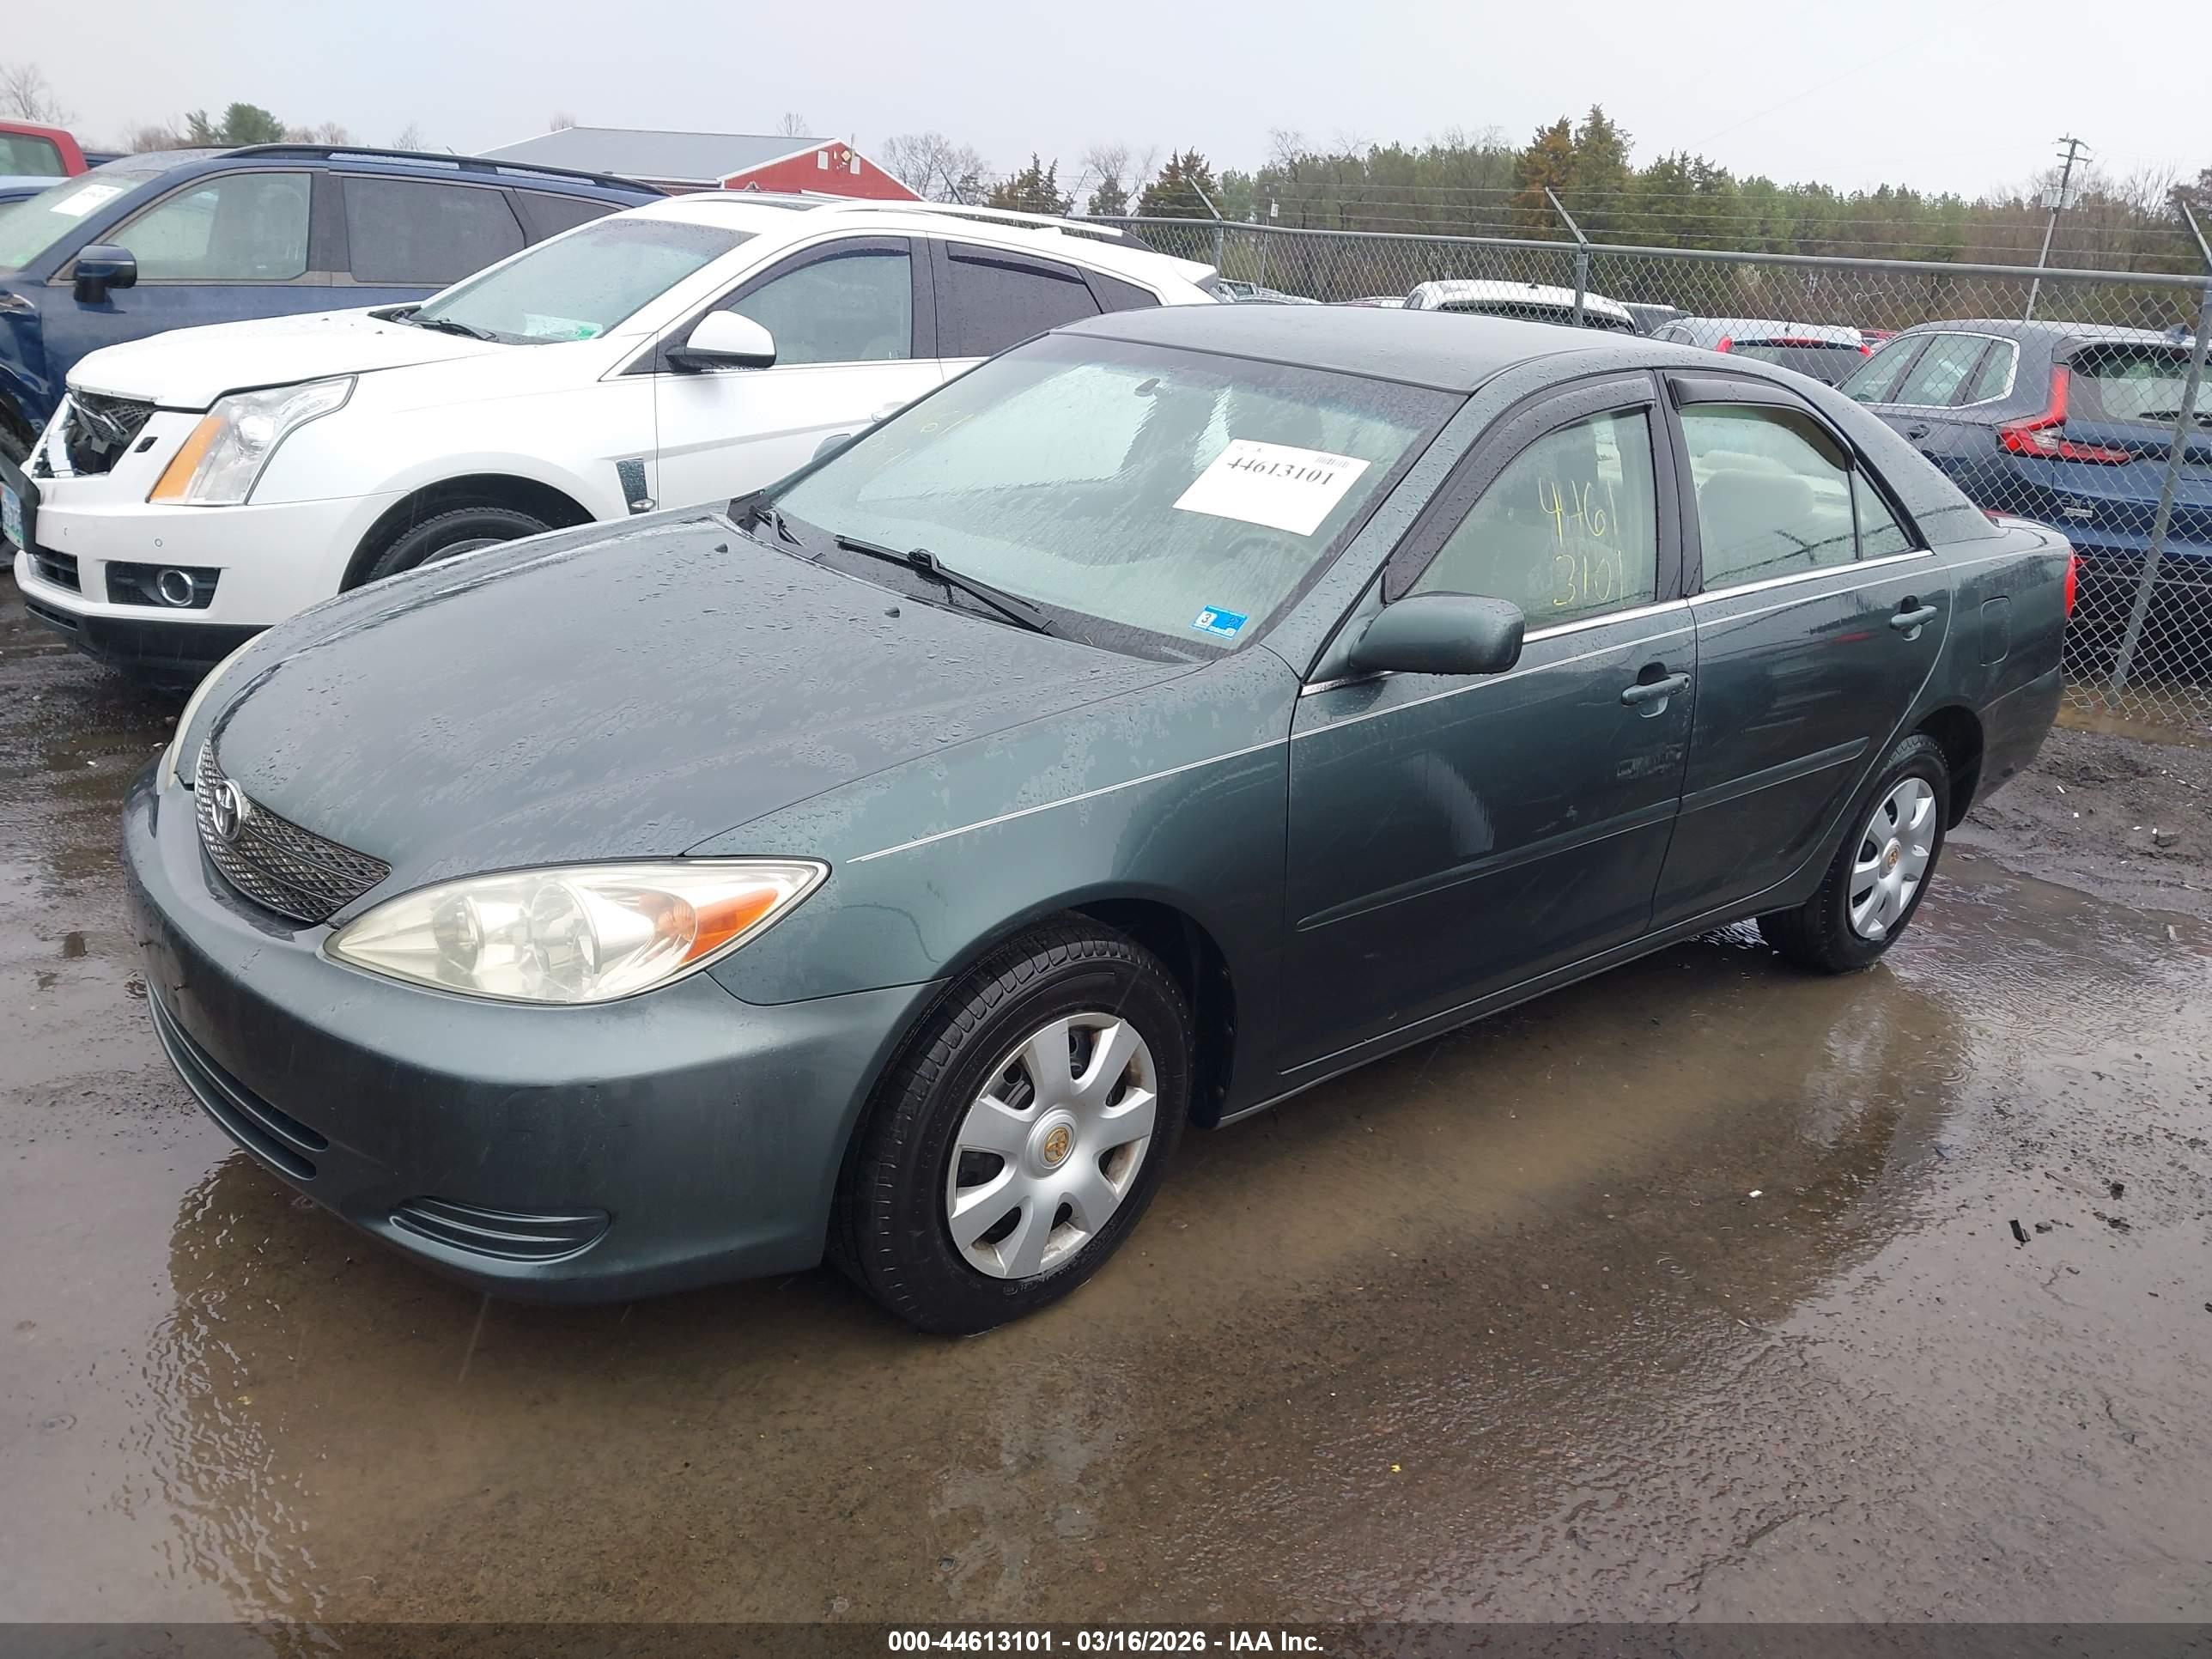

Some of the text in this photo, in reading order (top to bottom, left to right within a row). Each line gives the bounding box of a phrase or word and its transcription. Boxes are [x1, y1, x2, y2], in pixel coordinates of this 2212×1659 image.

[1227, 457, 1334, 485] 44613101
[1538, 476, 1619, 547] 4461
[1553, 550, 1623, 604] 3101
[1201, 613, 1212, 623] 3
